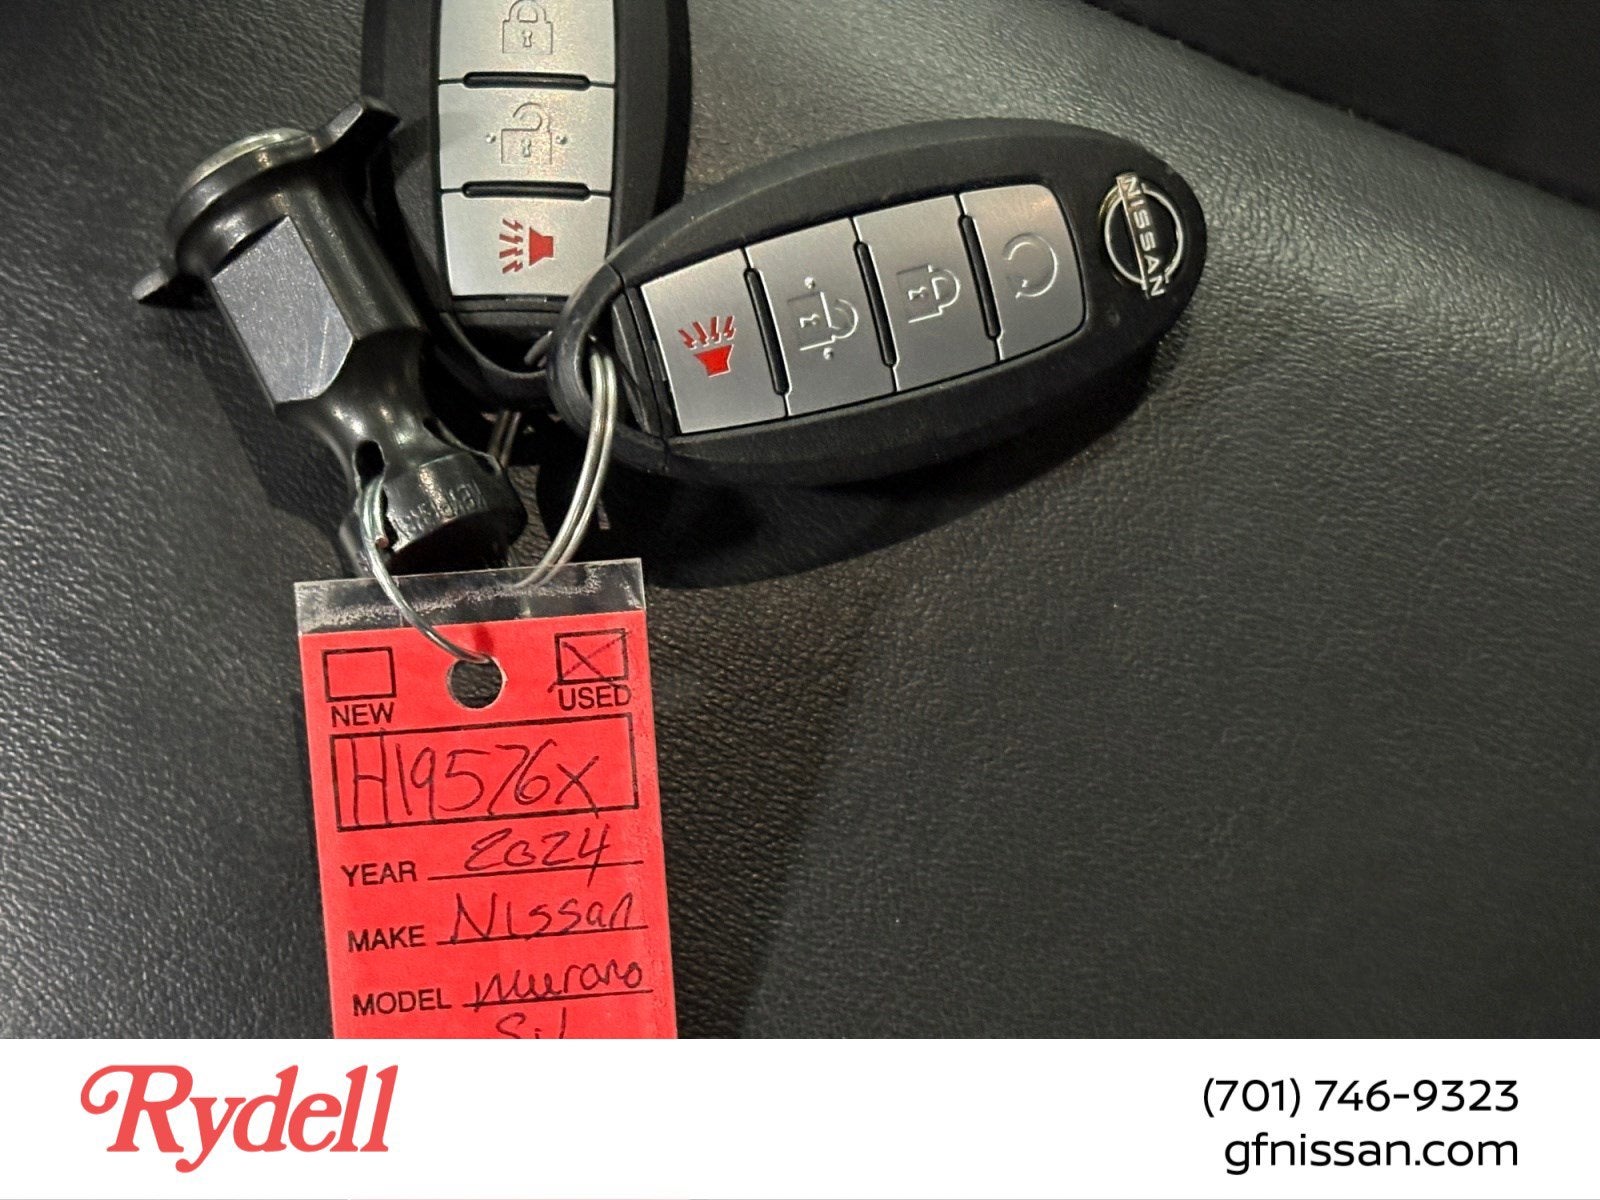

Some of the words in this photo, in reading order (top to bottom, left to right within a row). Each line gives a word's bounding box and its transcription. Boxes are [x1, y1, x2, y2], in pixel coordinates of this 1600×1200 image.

[1120, 174, 1166, 297] NISSAN
[558, 685, 632, 711] USED
[331, 702, 395, 726] NEW
[464, 824, 610, 887] 2024
[341, 861, 417, 887] YEAR
[450, 892, 634, 945] Nissan
[348, 924, 427, 953] MAKE
[352, 987, 453, 1018] MODEL
